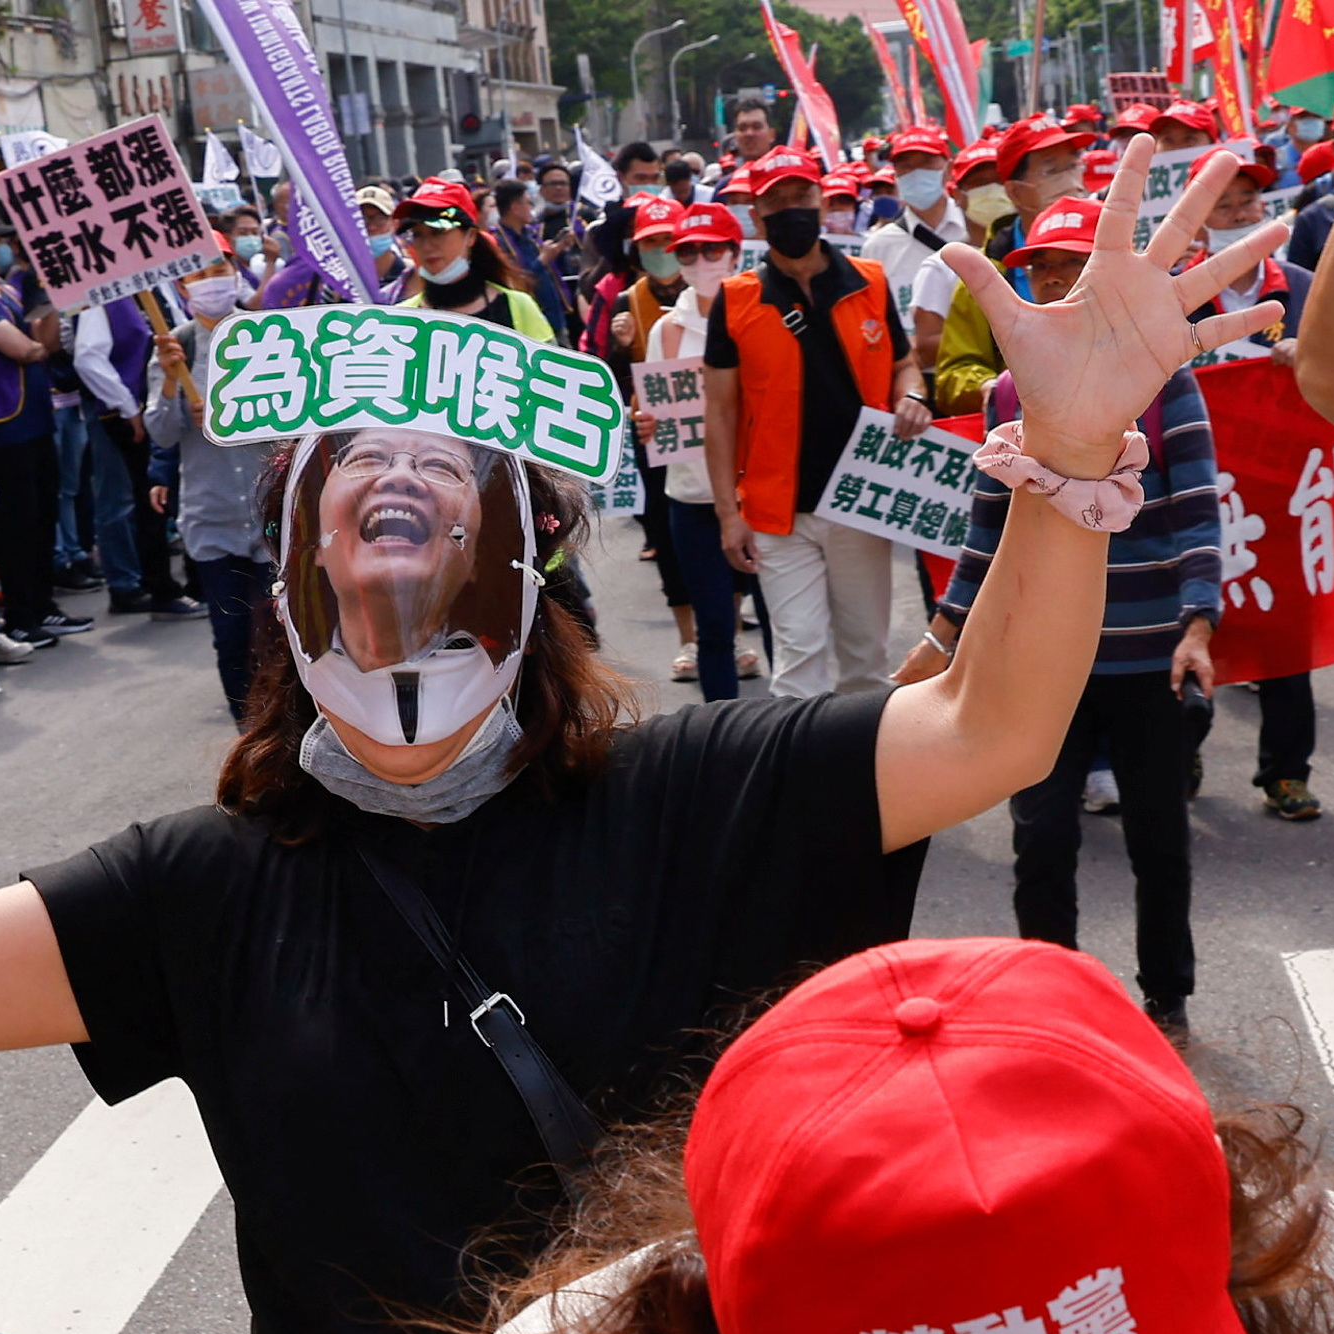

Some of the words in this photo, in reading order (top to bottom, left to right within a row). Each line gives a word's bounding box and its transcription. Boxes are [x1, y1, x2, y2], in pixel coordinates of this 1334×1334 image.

[3, 124, 176, 231] 什麼都漲
[28, 187, 205, 289] 薪水不漲
[217, 315, 614, 470] 為資喉舌
